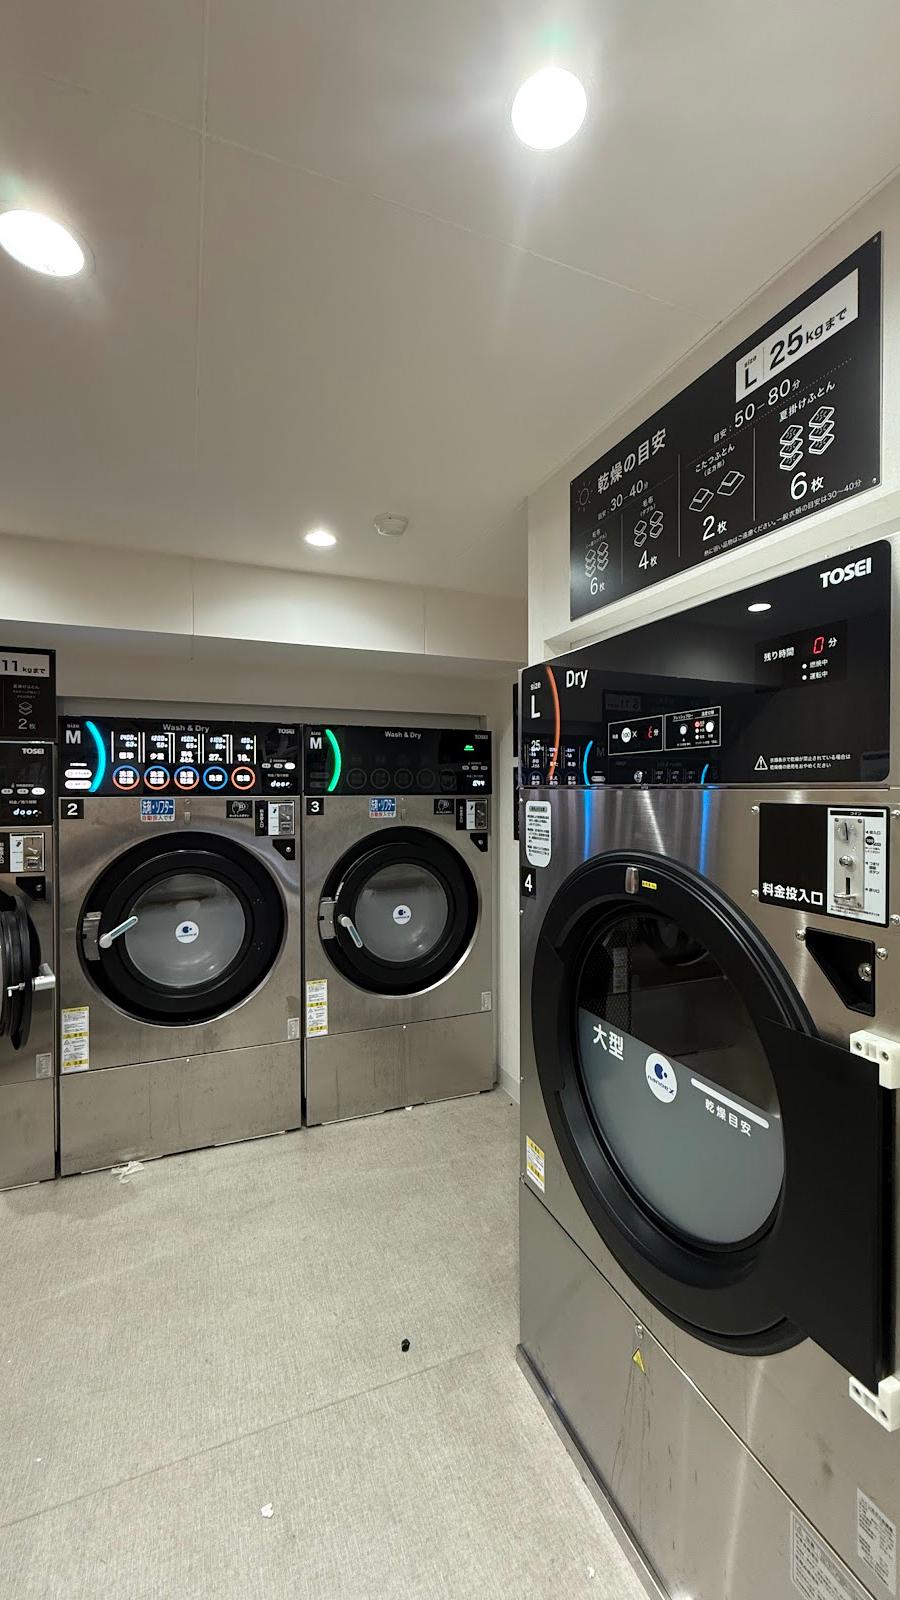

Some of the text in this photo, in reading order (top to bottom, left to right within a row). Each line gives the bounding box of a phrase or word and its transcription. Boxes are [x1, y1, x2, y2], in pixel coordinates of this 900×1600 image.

[745, 367, 758, 390] L
[779, 381, 836, 422] 夏掛けふとん
[597, 427, 667, 494] 乾燥の目安
[695, 443, 736, 473] こたつふとん
[702, 515, 728, 541] 2枚
[638, 550, 658, 570] 4枚
[819, 556, 872, 589] TOSEI
[763, 636, 838, 662] 残り時間 0 分
[530, 681, 542, 691] size
[565, 669, 589, 689] Dry
[530, 694, 541, 719] L
[65, 729, 82, 744] M
[163, 723, 210, 733] Wash & Dry
[410, 732, 422, 740] Dry
[309, 737, 322, 750] M
[66, 803, 78, 816] 2
[311, 801, 320, 812] 3
[524, 873, 533, 893] 4
[762, 882, 823, 906] 料金投入口
[592, 1023, 624, 1061] 大型
[705, 1098, 751, 1137] 乾燥目安
